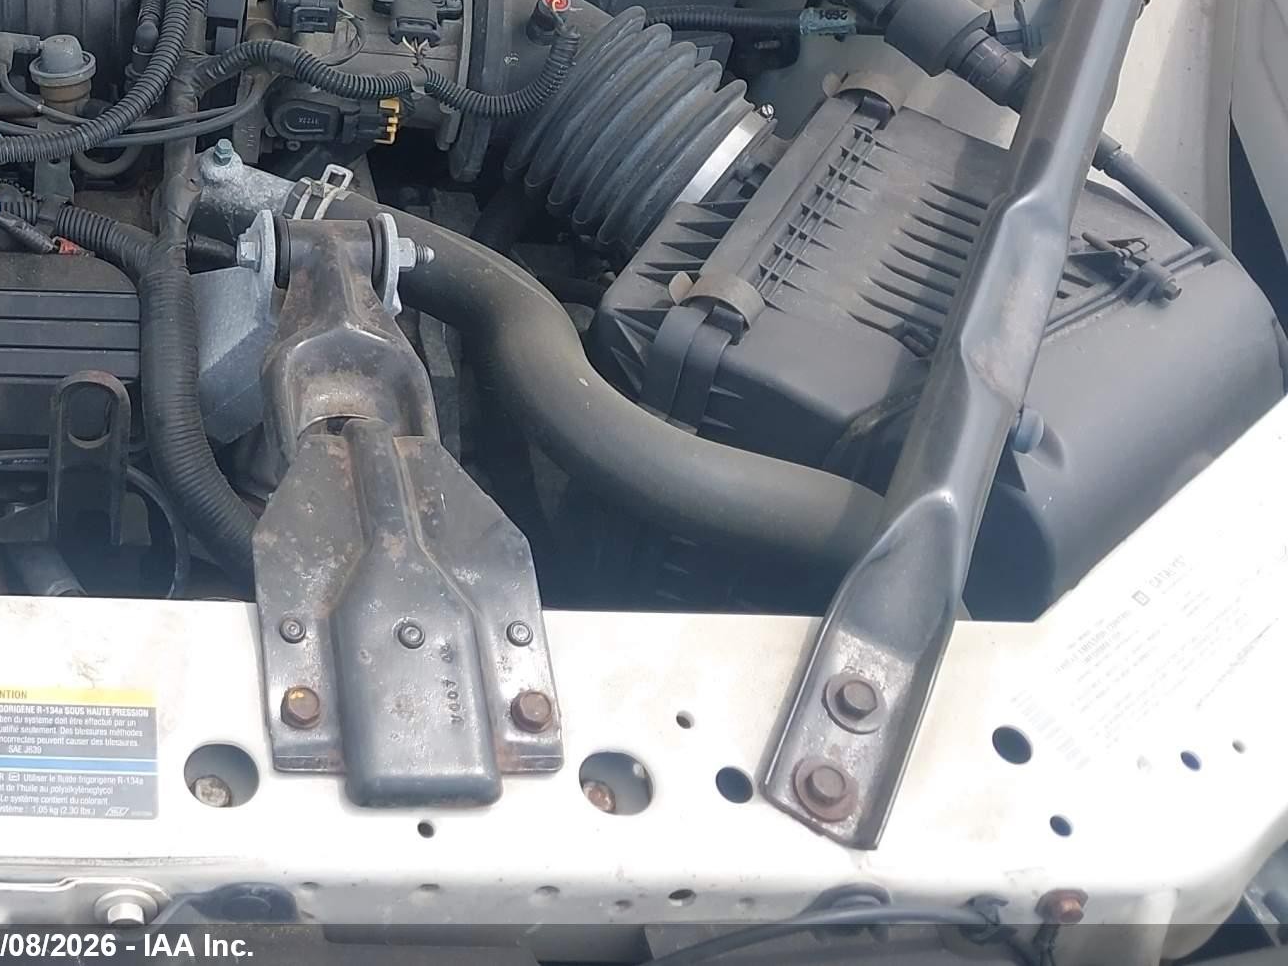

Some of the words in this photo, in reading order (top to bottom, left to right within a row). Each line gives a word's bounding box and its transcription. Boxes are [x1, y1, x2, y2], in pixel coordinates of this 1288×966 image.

[65, 707, 84, 715] SOUS
[87, 707, 110, 716] HAUTE
[112, 708, 149, 717] PRESSION
[14, 715, 23, 723] du
[114, 719, 126, 727] par
[60, 726, 73, 735] Des
[8, 745, 22, 753] SAE
[49, 775, 56, 783] le
[3, 784, 15, 792] de
[0, 794, 9, 803] Le
[41, 796, 68, 805] contient
[70, 796, 79, 805] du
[49, 806, 59, 816] kg
